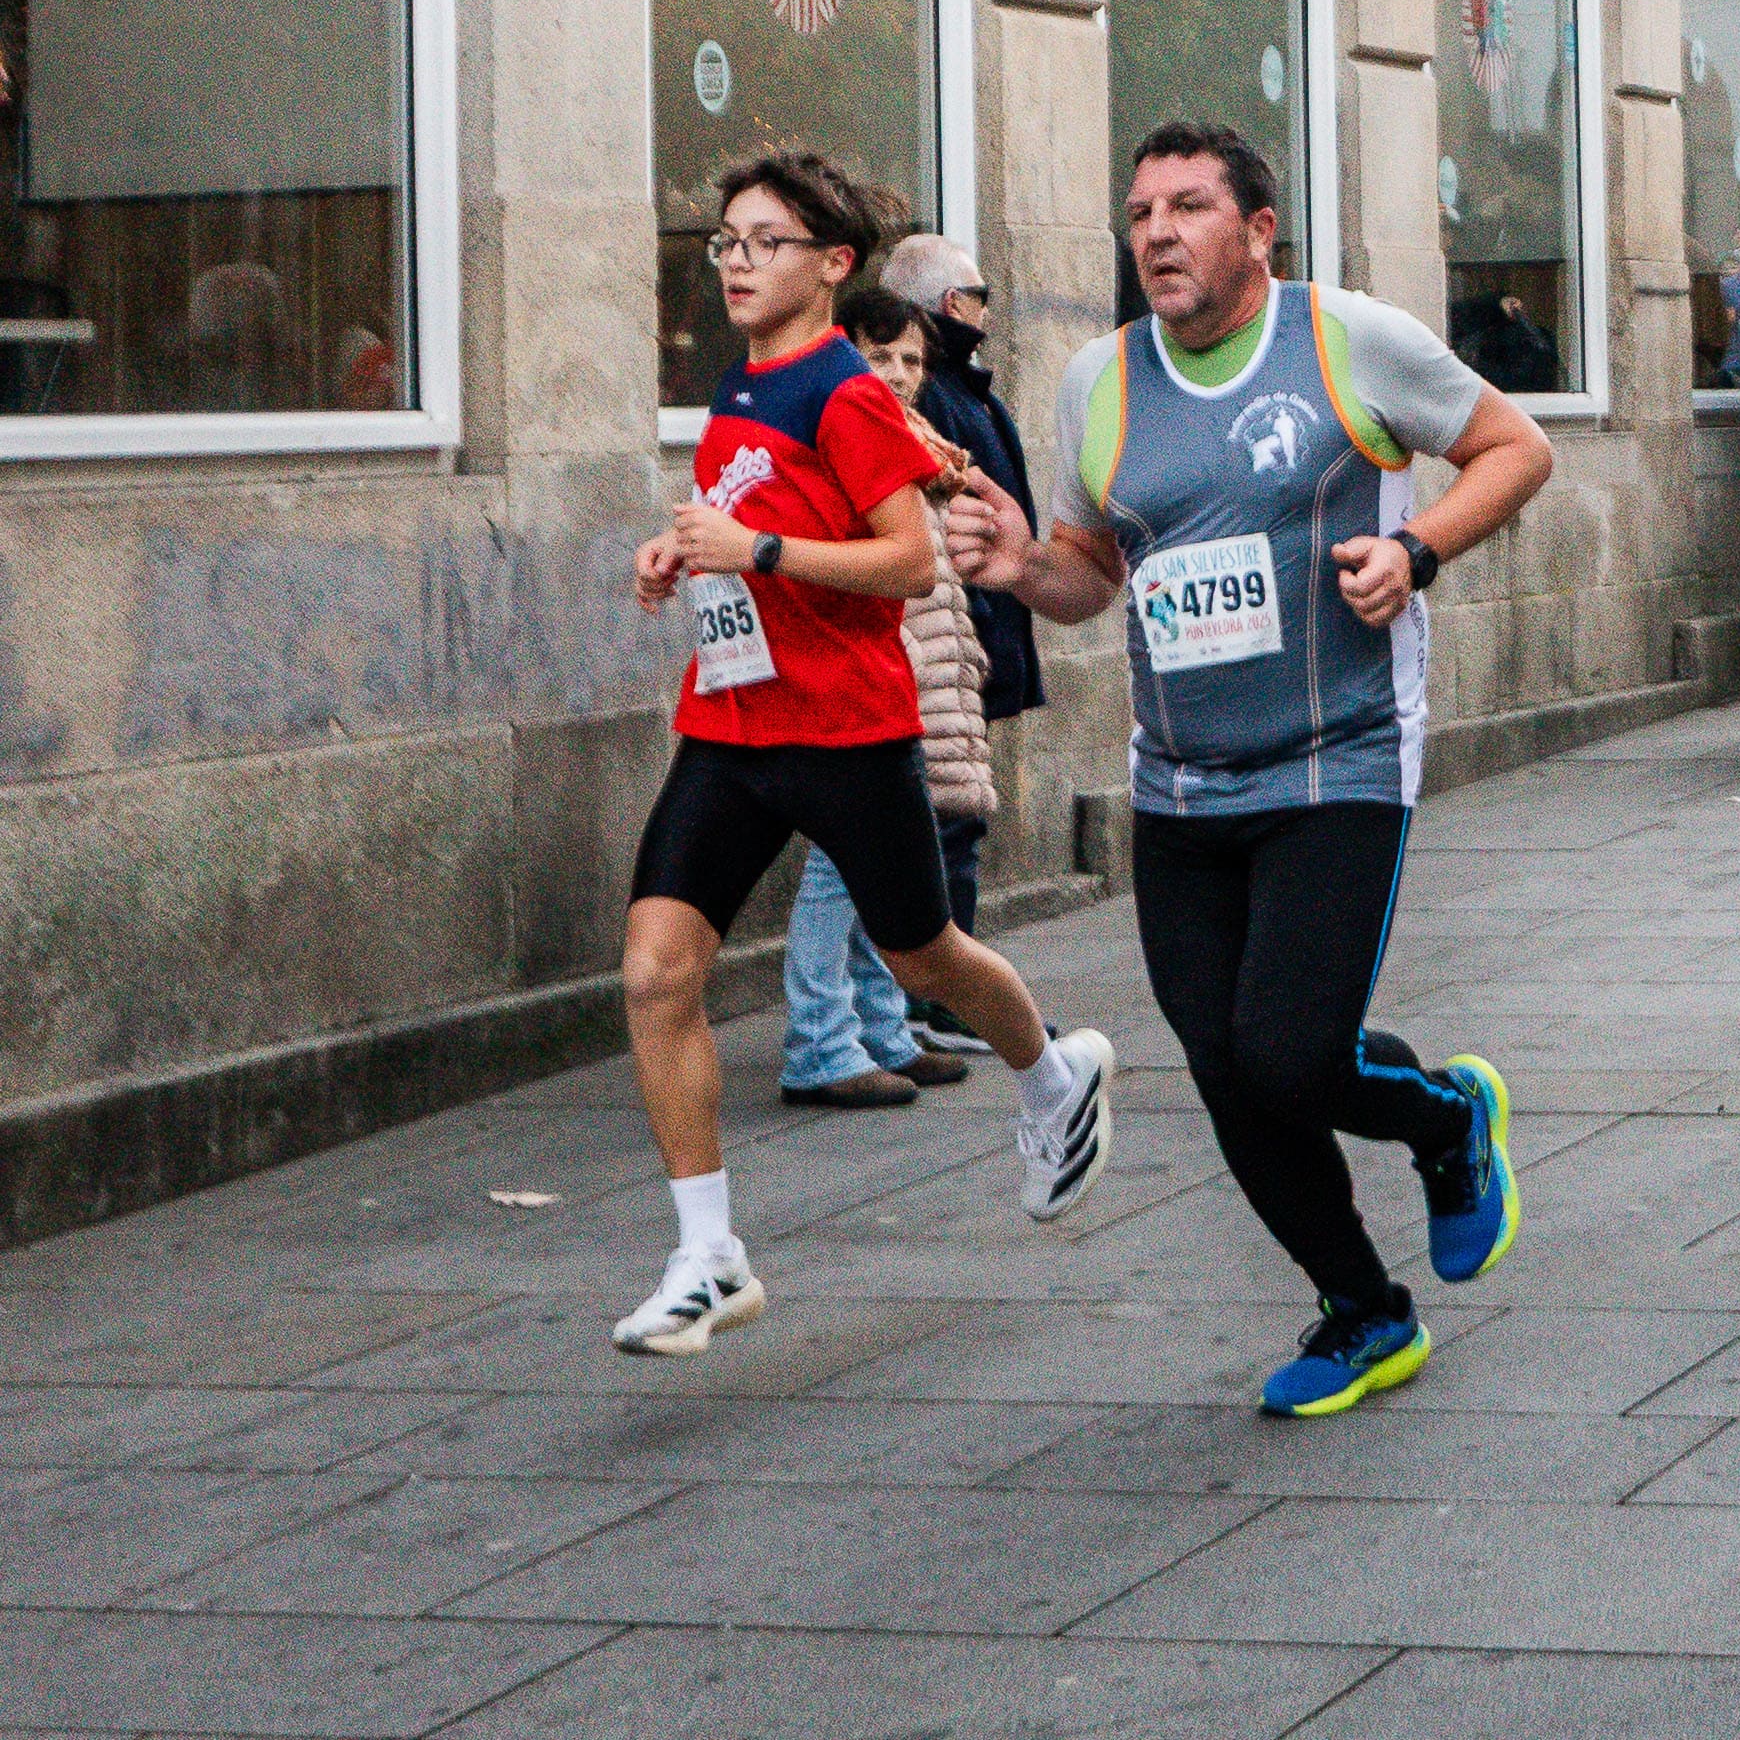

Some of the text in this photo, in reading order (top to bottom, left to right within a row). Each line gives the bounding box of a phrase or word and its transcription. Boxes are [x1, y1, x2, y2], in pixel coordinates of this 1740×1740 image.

[1161, 554, 1188, 580] SAN
[1190, 542, 1262, 575] SILVESTRE
[1182, 569, 1267, 617] 4799
[699, 596, 754, 645] 365
